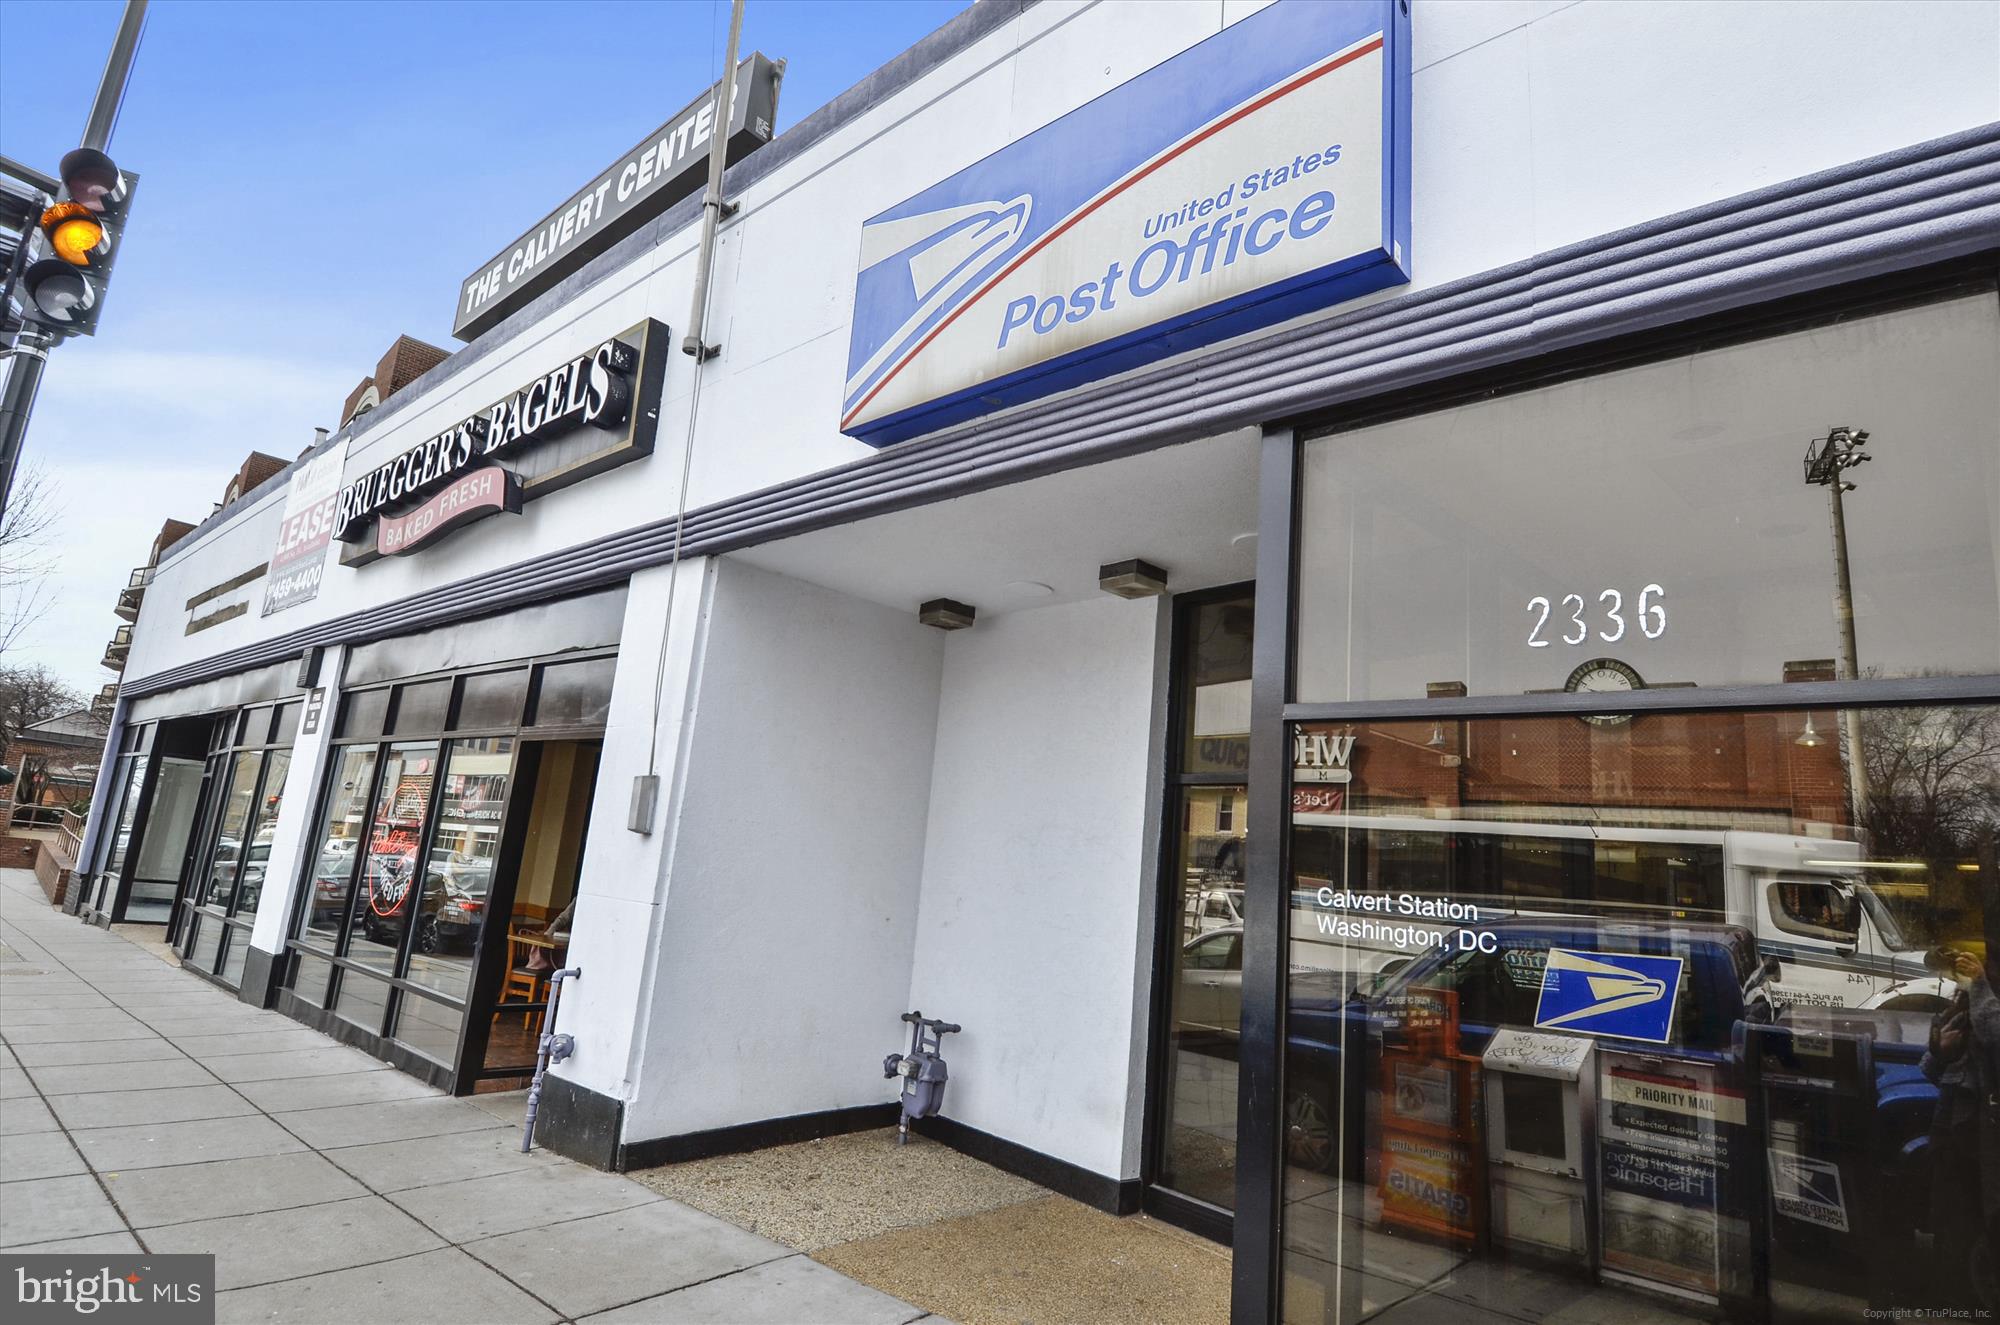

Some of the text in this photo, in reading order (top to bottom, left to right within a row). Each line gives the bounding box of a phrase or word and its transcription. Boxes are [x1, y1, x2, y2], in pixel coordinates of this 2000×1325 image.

[1143, 142, 1343, 240] United States
[465, 260, 504, 314] THE
[507, 179, 612, 283] CALVERT
[998, 188, 1336, 349] Post Office
[333, 342, 613, 540] BRUEGGER'S BAGELS
[276, 497, 336, 554] LEASE
[385, 473, 493, 546] BAKED FRESH
[1526, 582, 1667, 648] 2336
[1200, 738, 1249, 769] QUIC
[1316, 886, 1479, 922] Calvert Station
[1316, 913, 1498, 954] Washington, DC
[1634, 1085, 1716, 1113] PRIORITY MAIL
[1630, 1117, 1728, 1143] Expected delivery dates
[1650, 1135, 1688, 1147] insurance
[1689, 1143, 1701, 1153] up
[1702, 1144, 1712, 1153] to
[1630, 1143, 1730, 1170] Improved USPS Tracking
